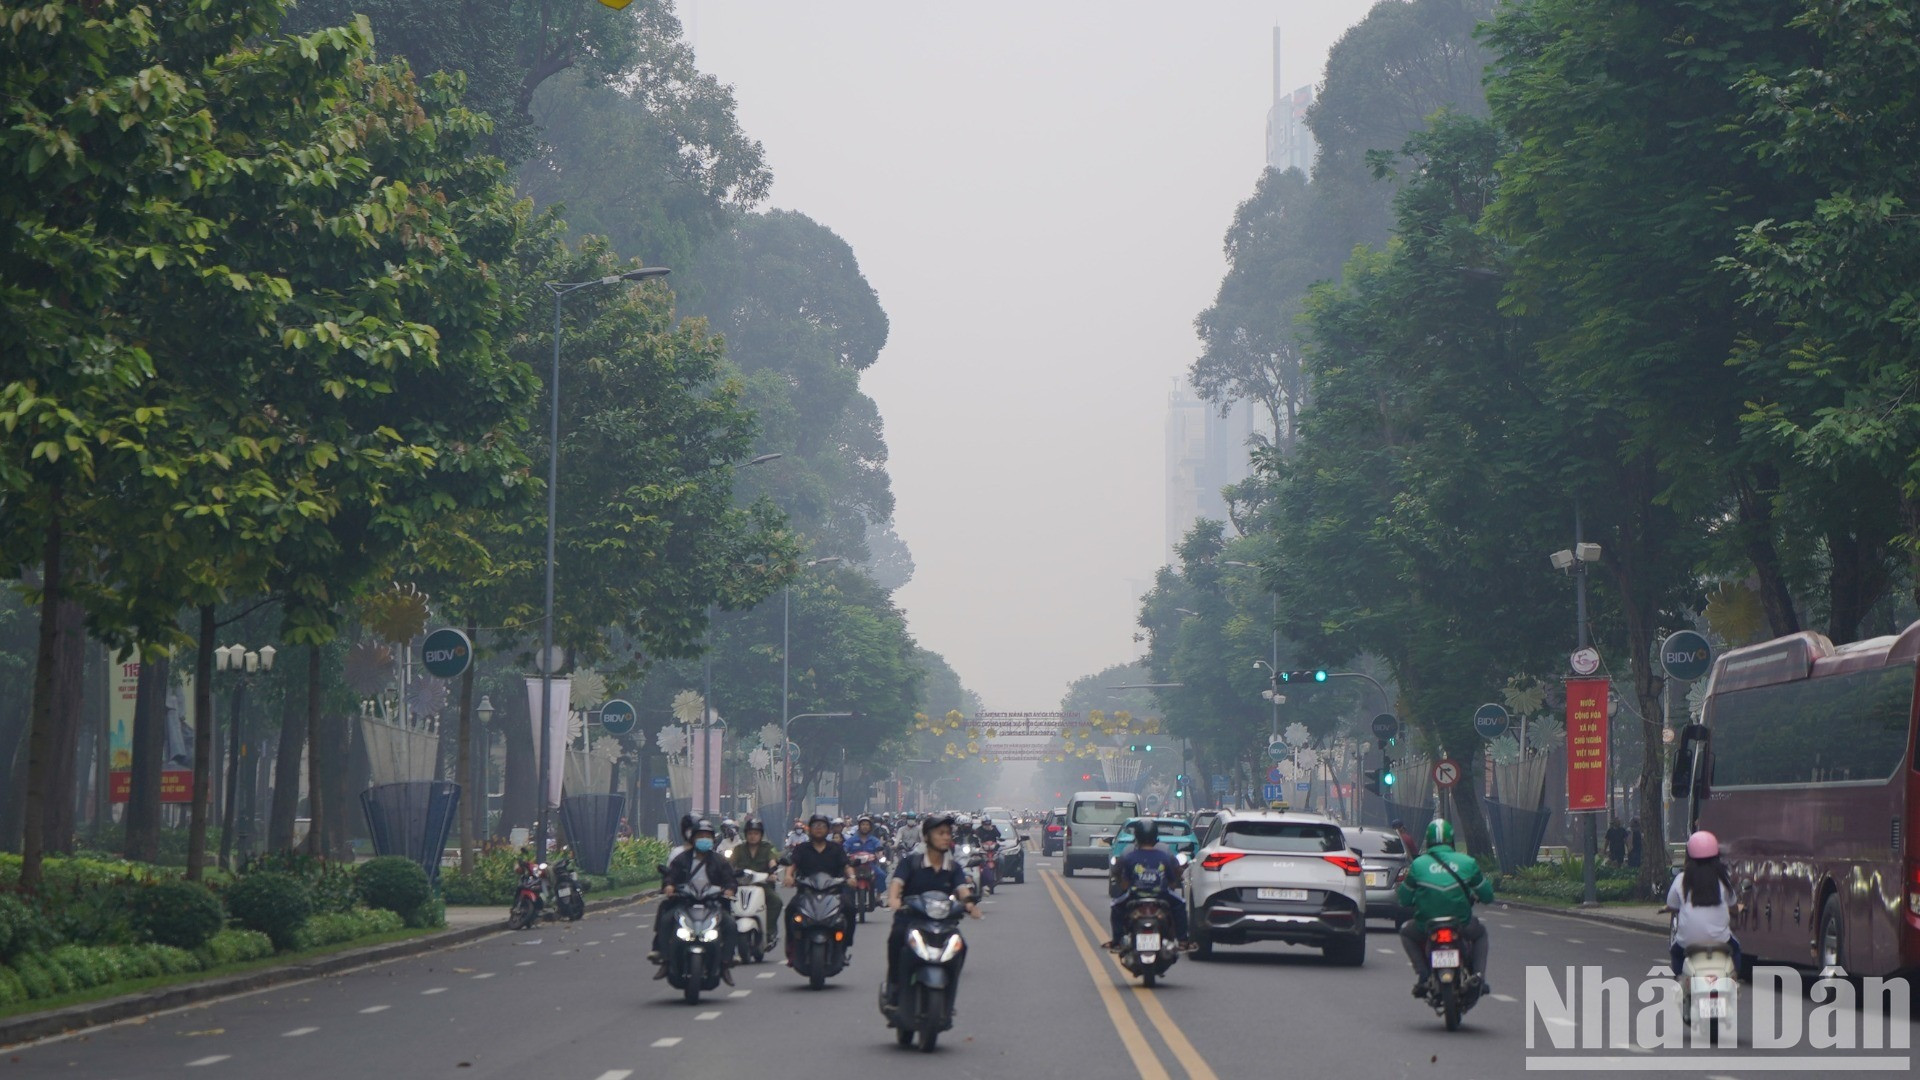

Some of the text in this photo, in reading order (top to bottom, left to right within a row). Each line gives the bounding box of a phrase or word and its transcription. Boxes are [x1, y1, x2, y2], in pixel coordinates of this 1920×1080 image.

[425, 649, 455, 663] BIDV
[1666, 651, 1696, 664] BIDV
[603, 714, 625, 722] BIDV
[1477, 717, 1498, 726] BIDV
